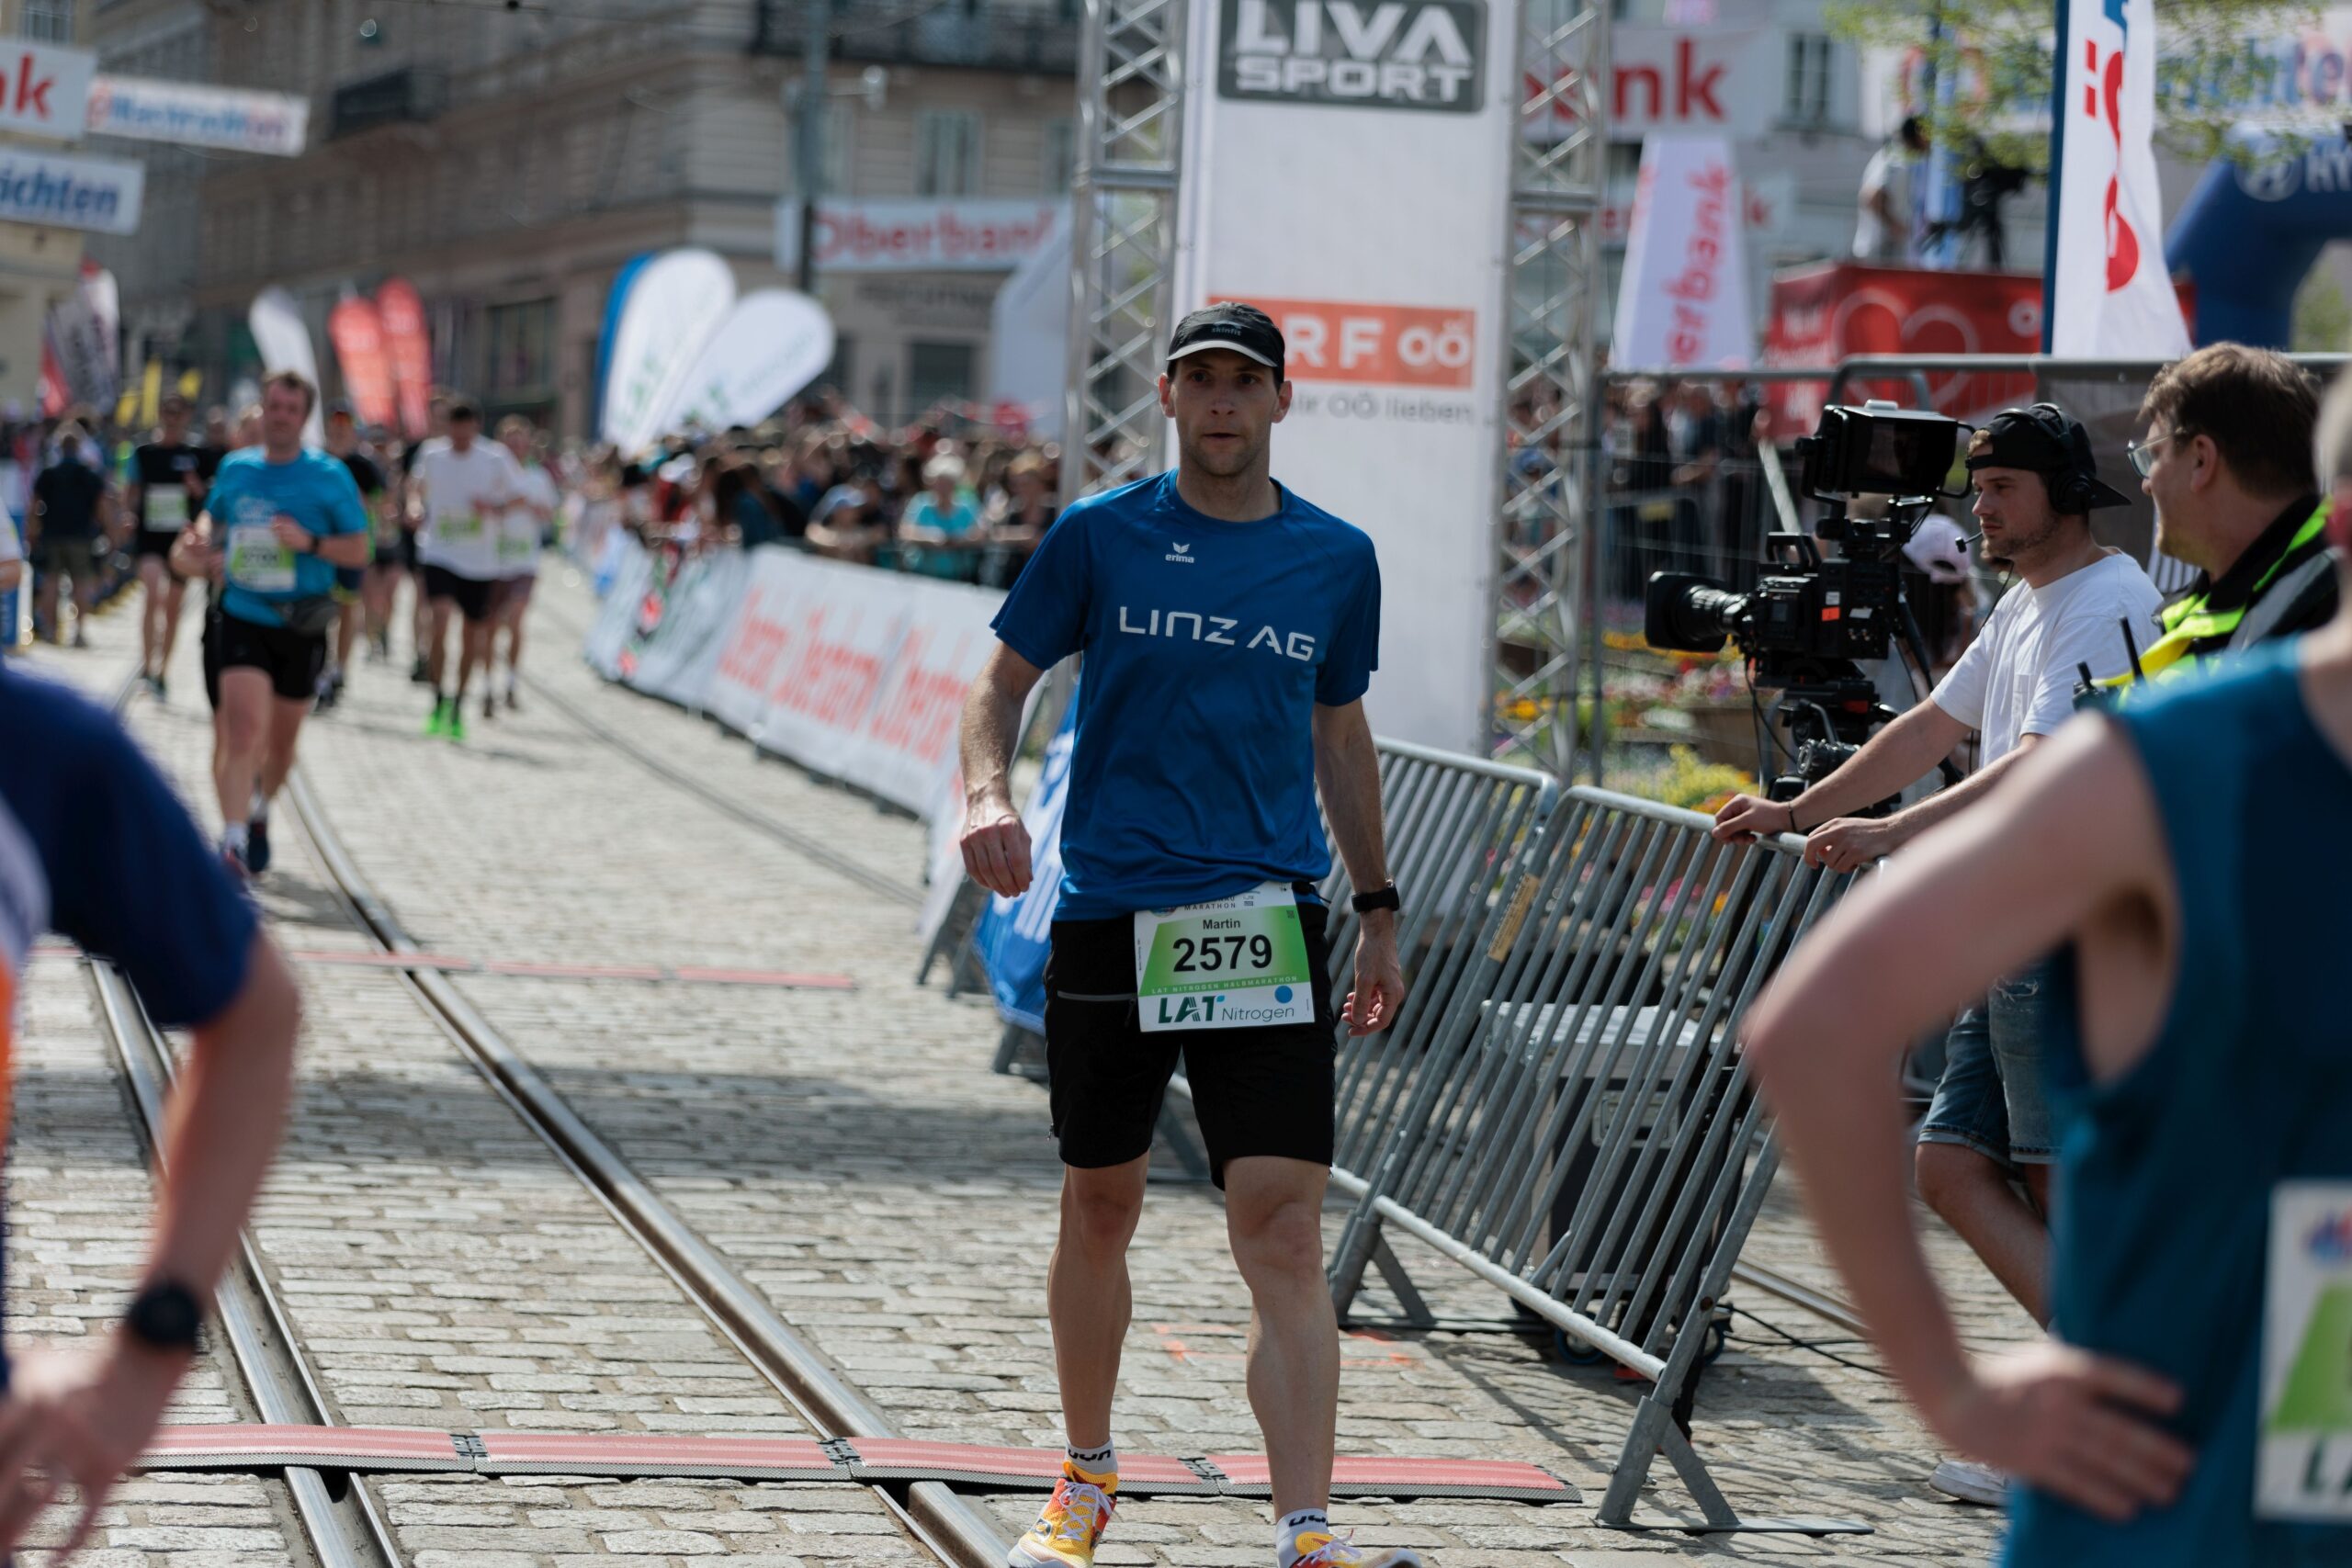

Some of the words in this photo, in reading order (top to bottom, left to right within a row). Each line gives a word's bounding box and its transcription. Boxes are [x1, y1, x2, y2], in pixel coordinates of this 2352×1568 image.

[1236, 0, 1471, 66] LIVA
[1236, 55, 1472, 102] SPORT
[1282, 314, 1385, 368] RF
[1165, 553, 1194, 564] erima
[1119, 606, 1238, 646] LINZ
[1247, 625, 1316, 661] AG
[1184, 902, 1237, 911] MARATHON
[1203, 919, 1240, 930] Martin
[1172, 934, 1272, 973] 2579
[1172, 983, 1219, 993] NITROGEN
[1224, 976, 1297, 988] HALBMARATHON
[1159, 995, 1218, 1024] LAT
[1222, 1007, 1295, 1022] Nitrogen
